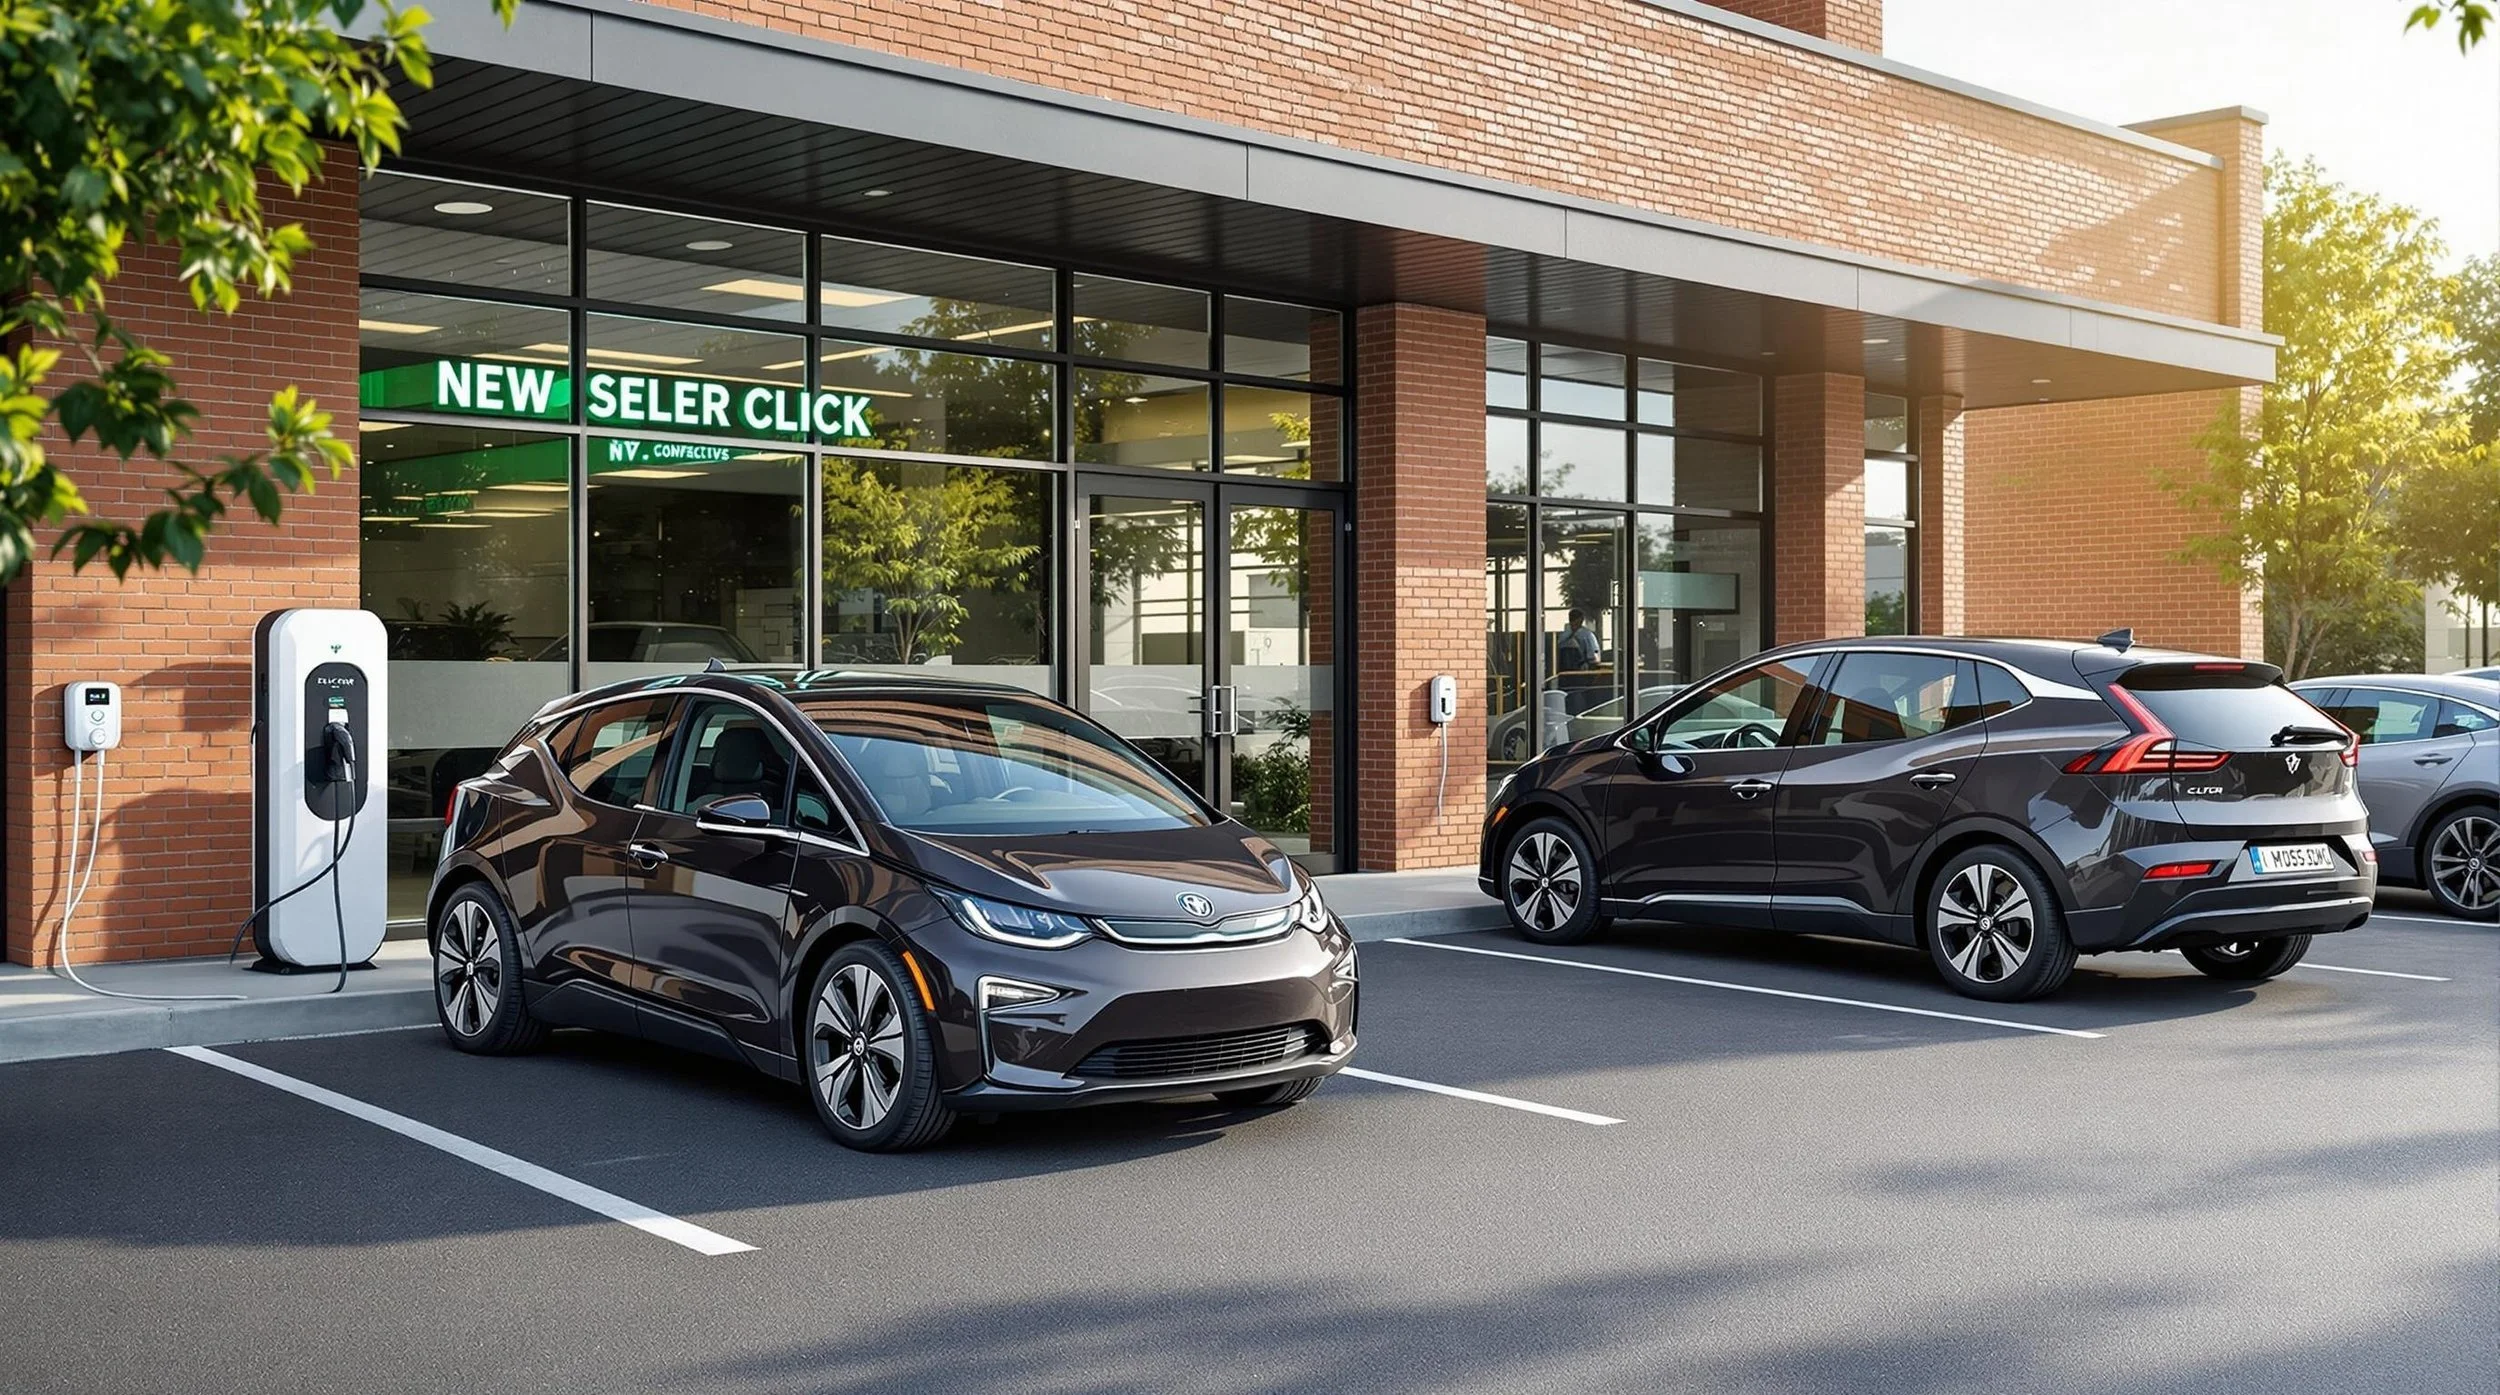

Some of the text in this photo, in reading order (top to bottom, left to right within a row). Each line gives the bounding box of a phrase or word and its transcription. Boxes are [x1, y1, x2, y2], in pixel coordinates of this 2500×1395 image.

[438, 360, 871, 437] NEW SELER CLICK
